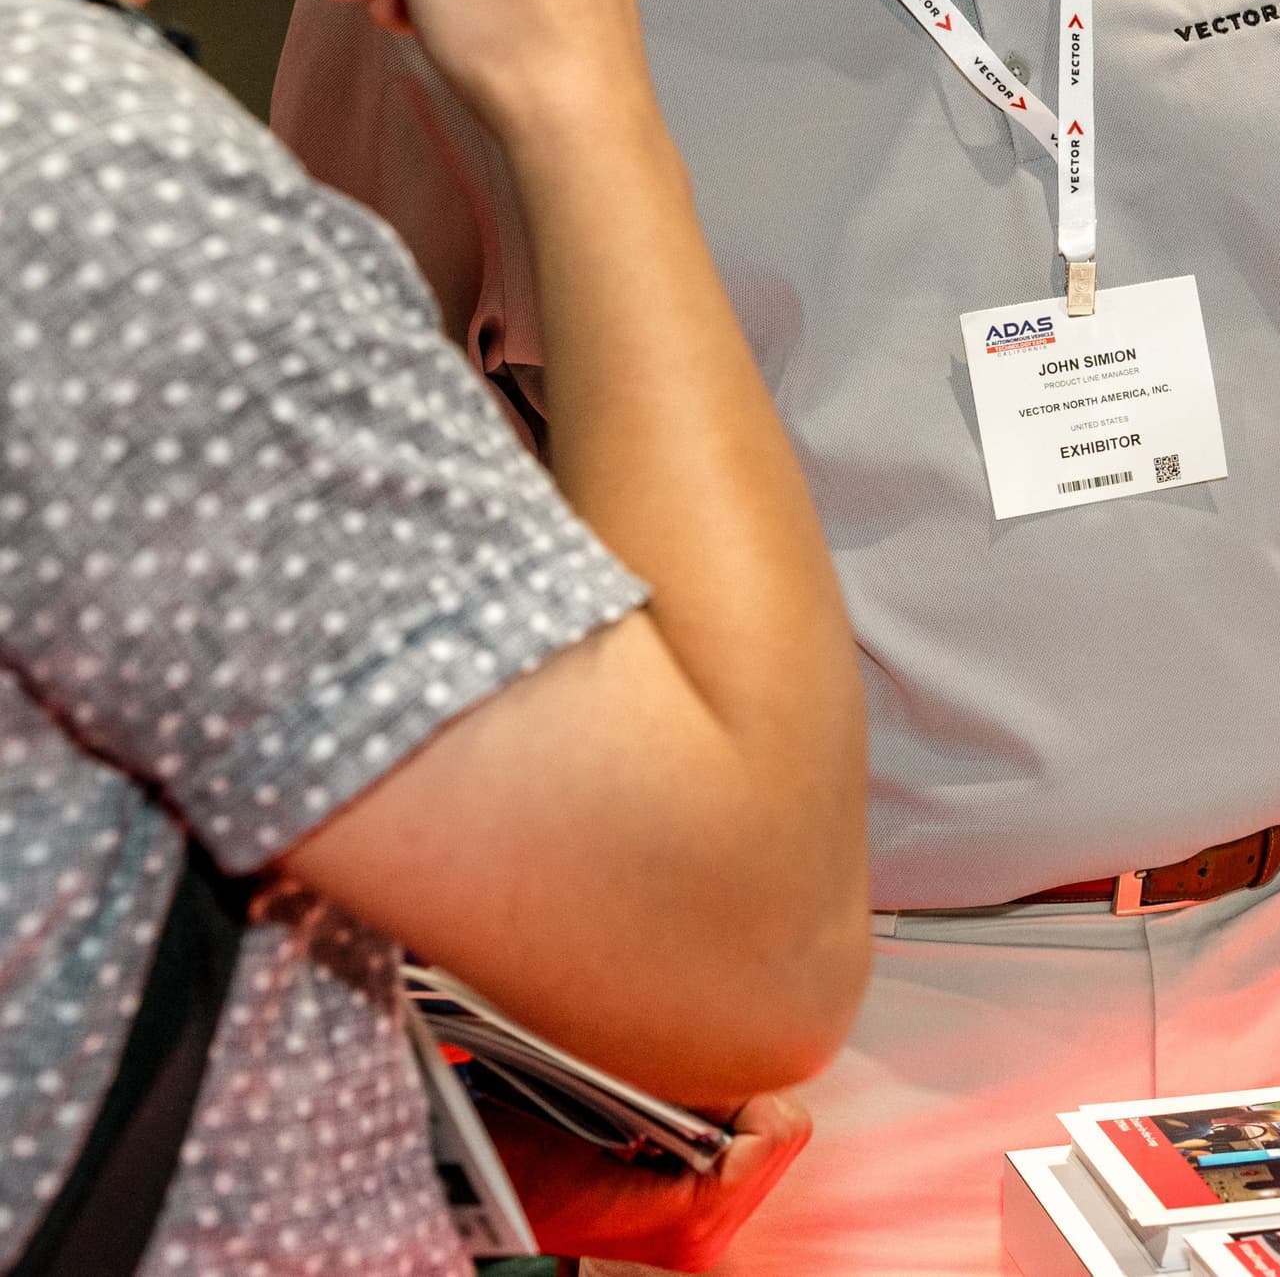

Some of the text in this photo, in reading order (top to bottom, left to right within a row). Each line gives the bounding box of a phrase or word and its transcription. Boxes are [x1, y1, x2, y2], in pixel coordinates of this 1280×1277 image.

[1174, 4, 1280, 42] VECTOR
[1070, 32, 1082, 87] VECTOR
[972, 55, 1017, 102] VECTOR
[1071, 140, 1080, 194] VECTOR
[986, 316, 1054, 341] ADAS
[992, 335, 1031, 347] AUTONOMOUS
[1031, 330, 1055, 340] VEHICLE
[1038, 348, 1137, 377] JOHN SIMION
[1044, 367, 1140, 390] PRODUCT LINE MANAGER
[1018, 383, 1172, 418] VECTOR NORTH AMERICA, INC.
[1070, 415, 1129, 432] UNITED STATES
[1060, 433, 1141, 459] EXHIBITOR
